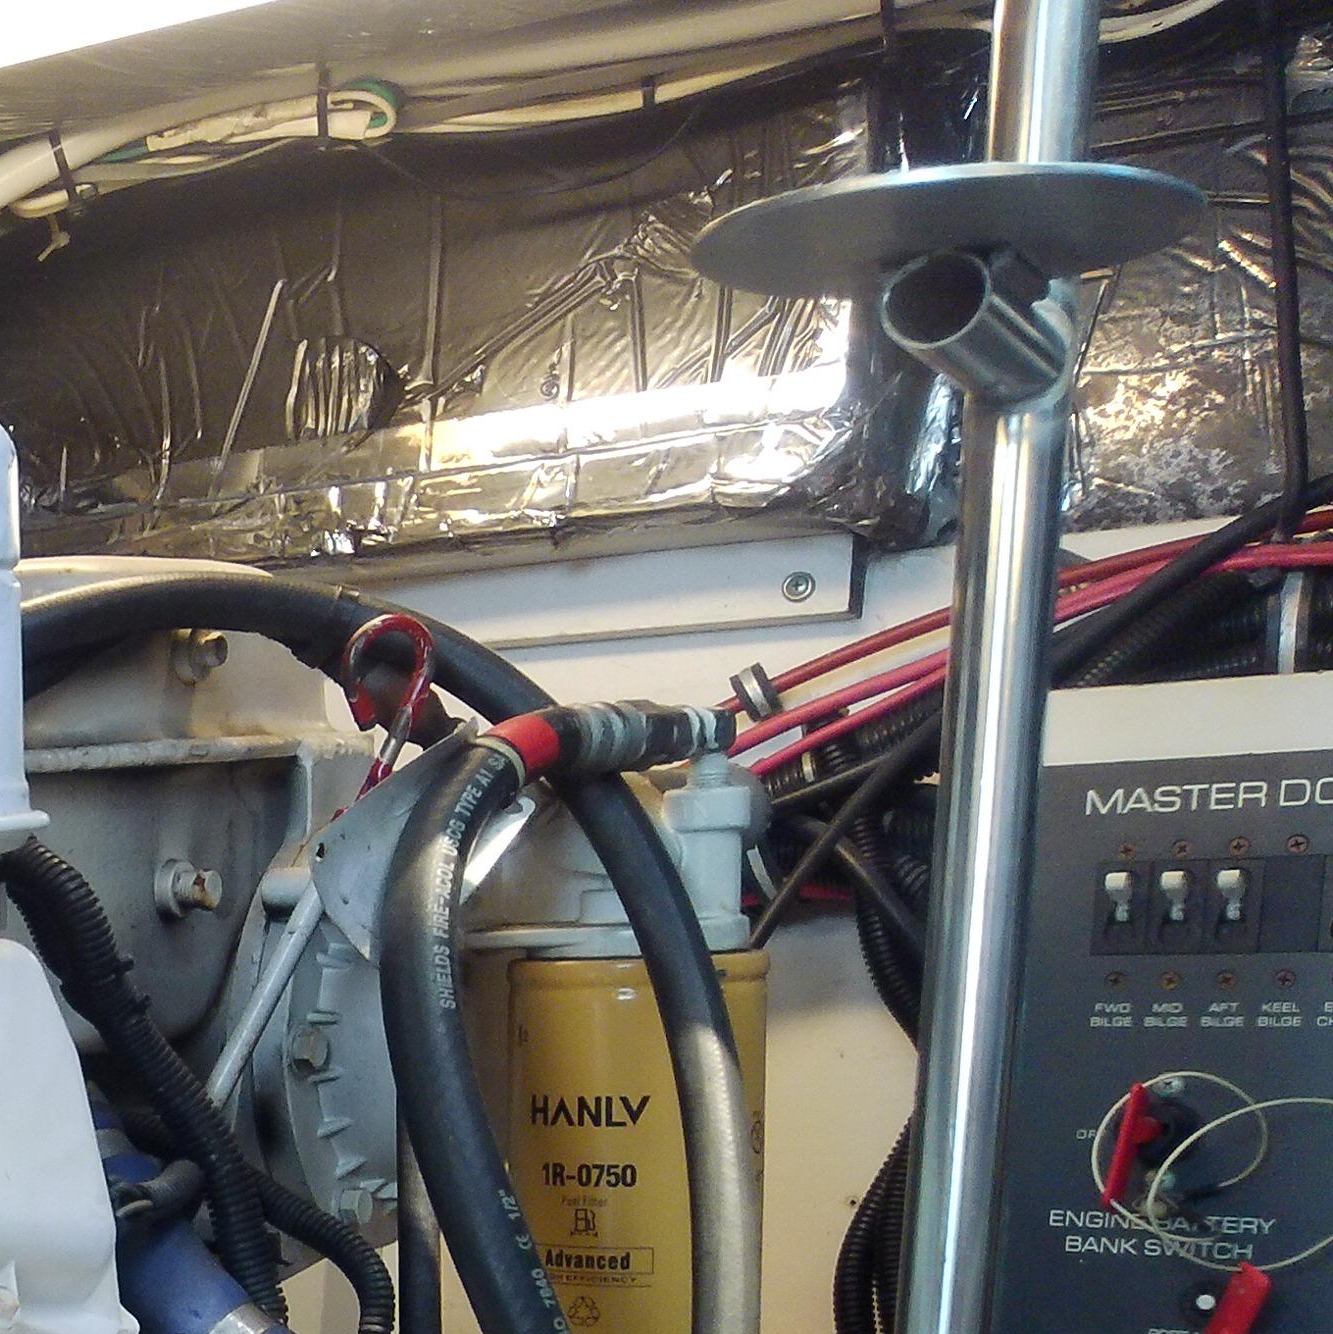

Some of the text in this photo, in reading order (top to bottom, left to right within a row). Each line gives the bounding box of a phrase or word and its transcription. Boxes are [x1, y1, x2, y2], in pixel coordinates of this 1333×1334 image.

[454, 786, 483, 816] TYPE
[1085, 780, 1268, 816] MASTER
[442, 820, 466, 857] USCG
[434, 862, 455, 938] FIRE-ACOL
[434, 945, 457, 1010] SHIELDS
[1094, 1003, 1131, 1013] FWD
[1152, 1002, 1183, 1013] MID
[1208, 1002, 1240, 1013] AFT
[1261, 1002, 1301, 1013] KEEL
[1090, 1016, 1133, 1027] BILGE
[1143, 1016, 1187, 1027] BILGE
[1200, 1016, 1244, 1027] BILGE
[1257, 1016, 1302, 1027] BILGE
[542, 1162, 637, 1189] 1R-0750
[1152, 1215, 1276, 1235] BATERY
[545, 1247, 631, 1271] Advanced
[1065, 1236, 1253, 1260] BANK SWITCH
